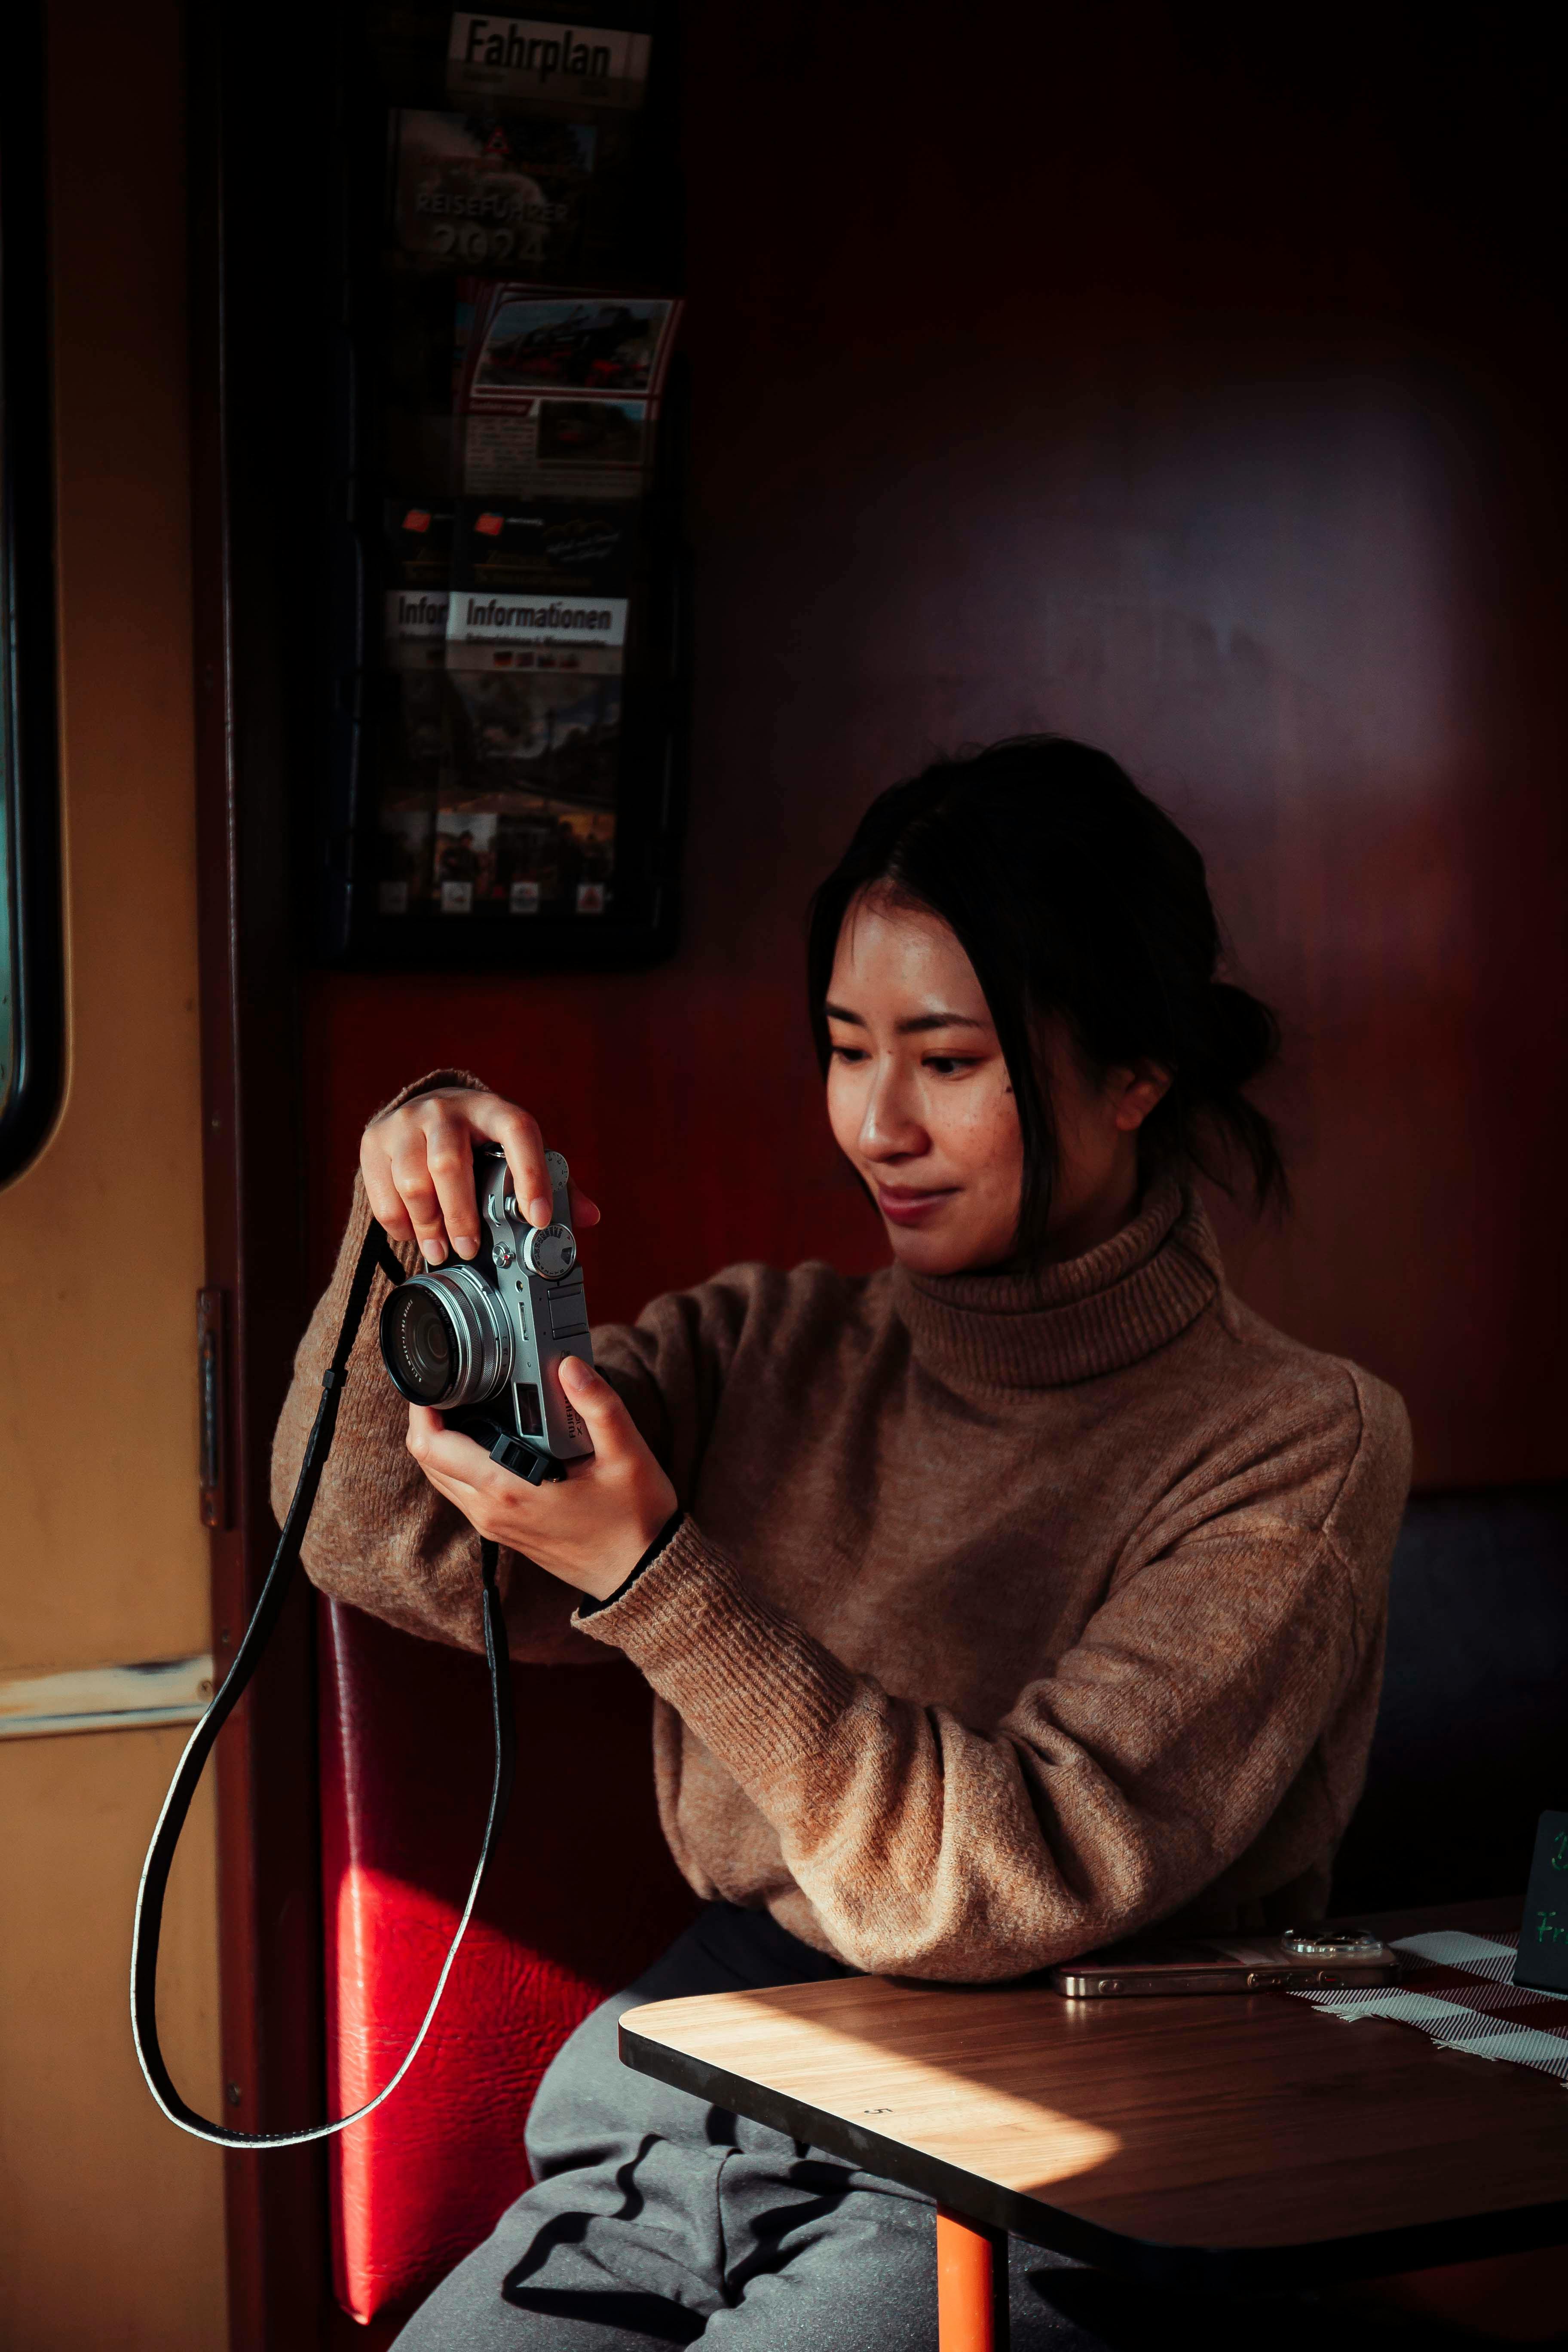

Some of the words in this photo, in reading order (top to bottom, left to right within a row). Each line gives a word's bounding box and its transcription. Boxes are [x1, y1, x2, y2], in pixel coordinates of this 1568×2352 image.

[465, 19, 611, 83] Fahrplan
[398, 596, 447, 625] Infor
[466, 598, 611, 630] Informationen
[403, 1299, 413, 1317] SUPER
[564, 1396, 576, 1439] FUJIFILM
[574, 1411, 583, 1436] X10
[1537, 1911, 1568, 1945] Fr
